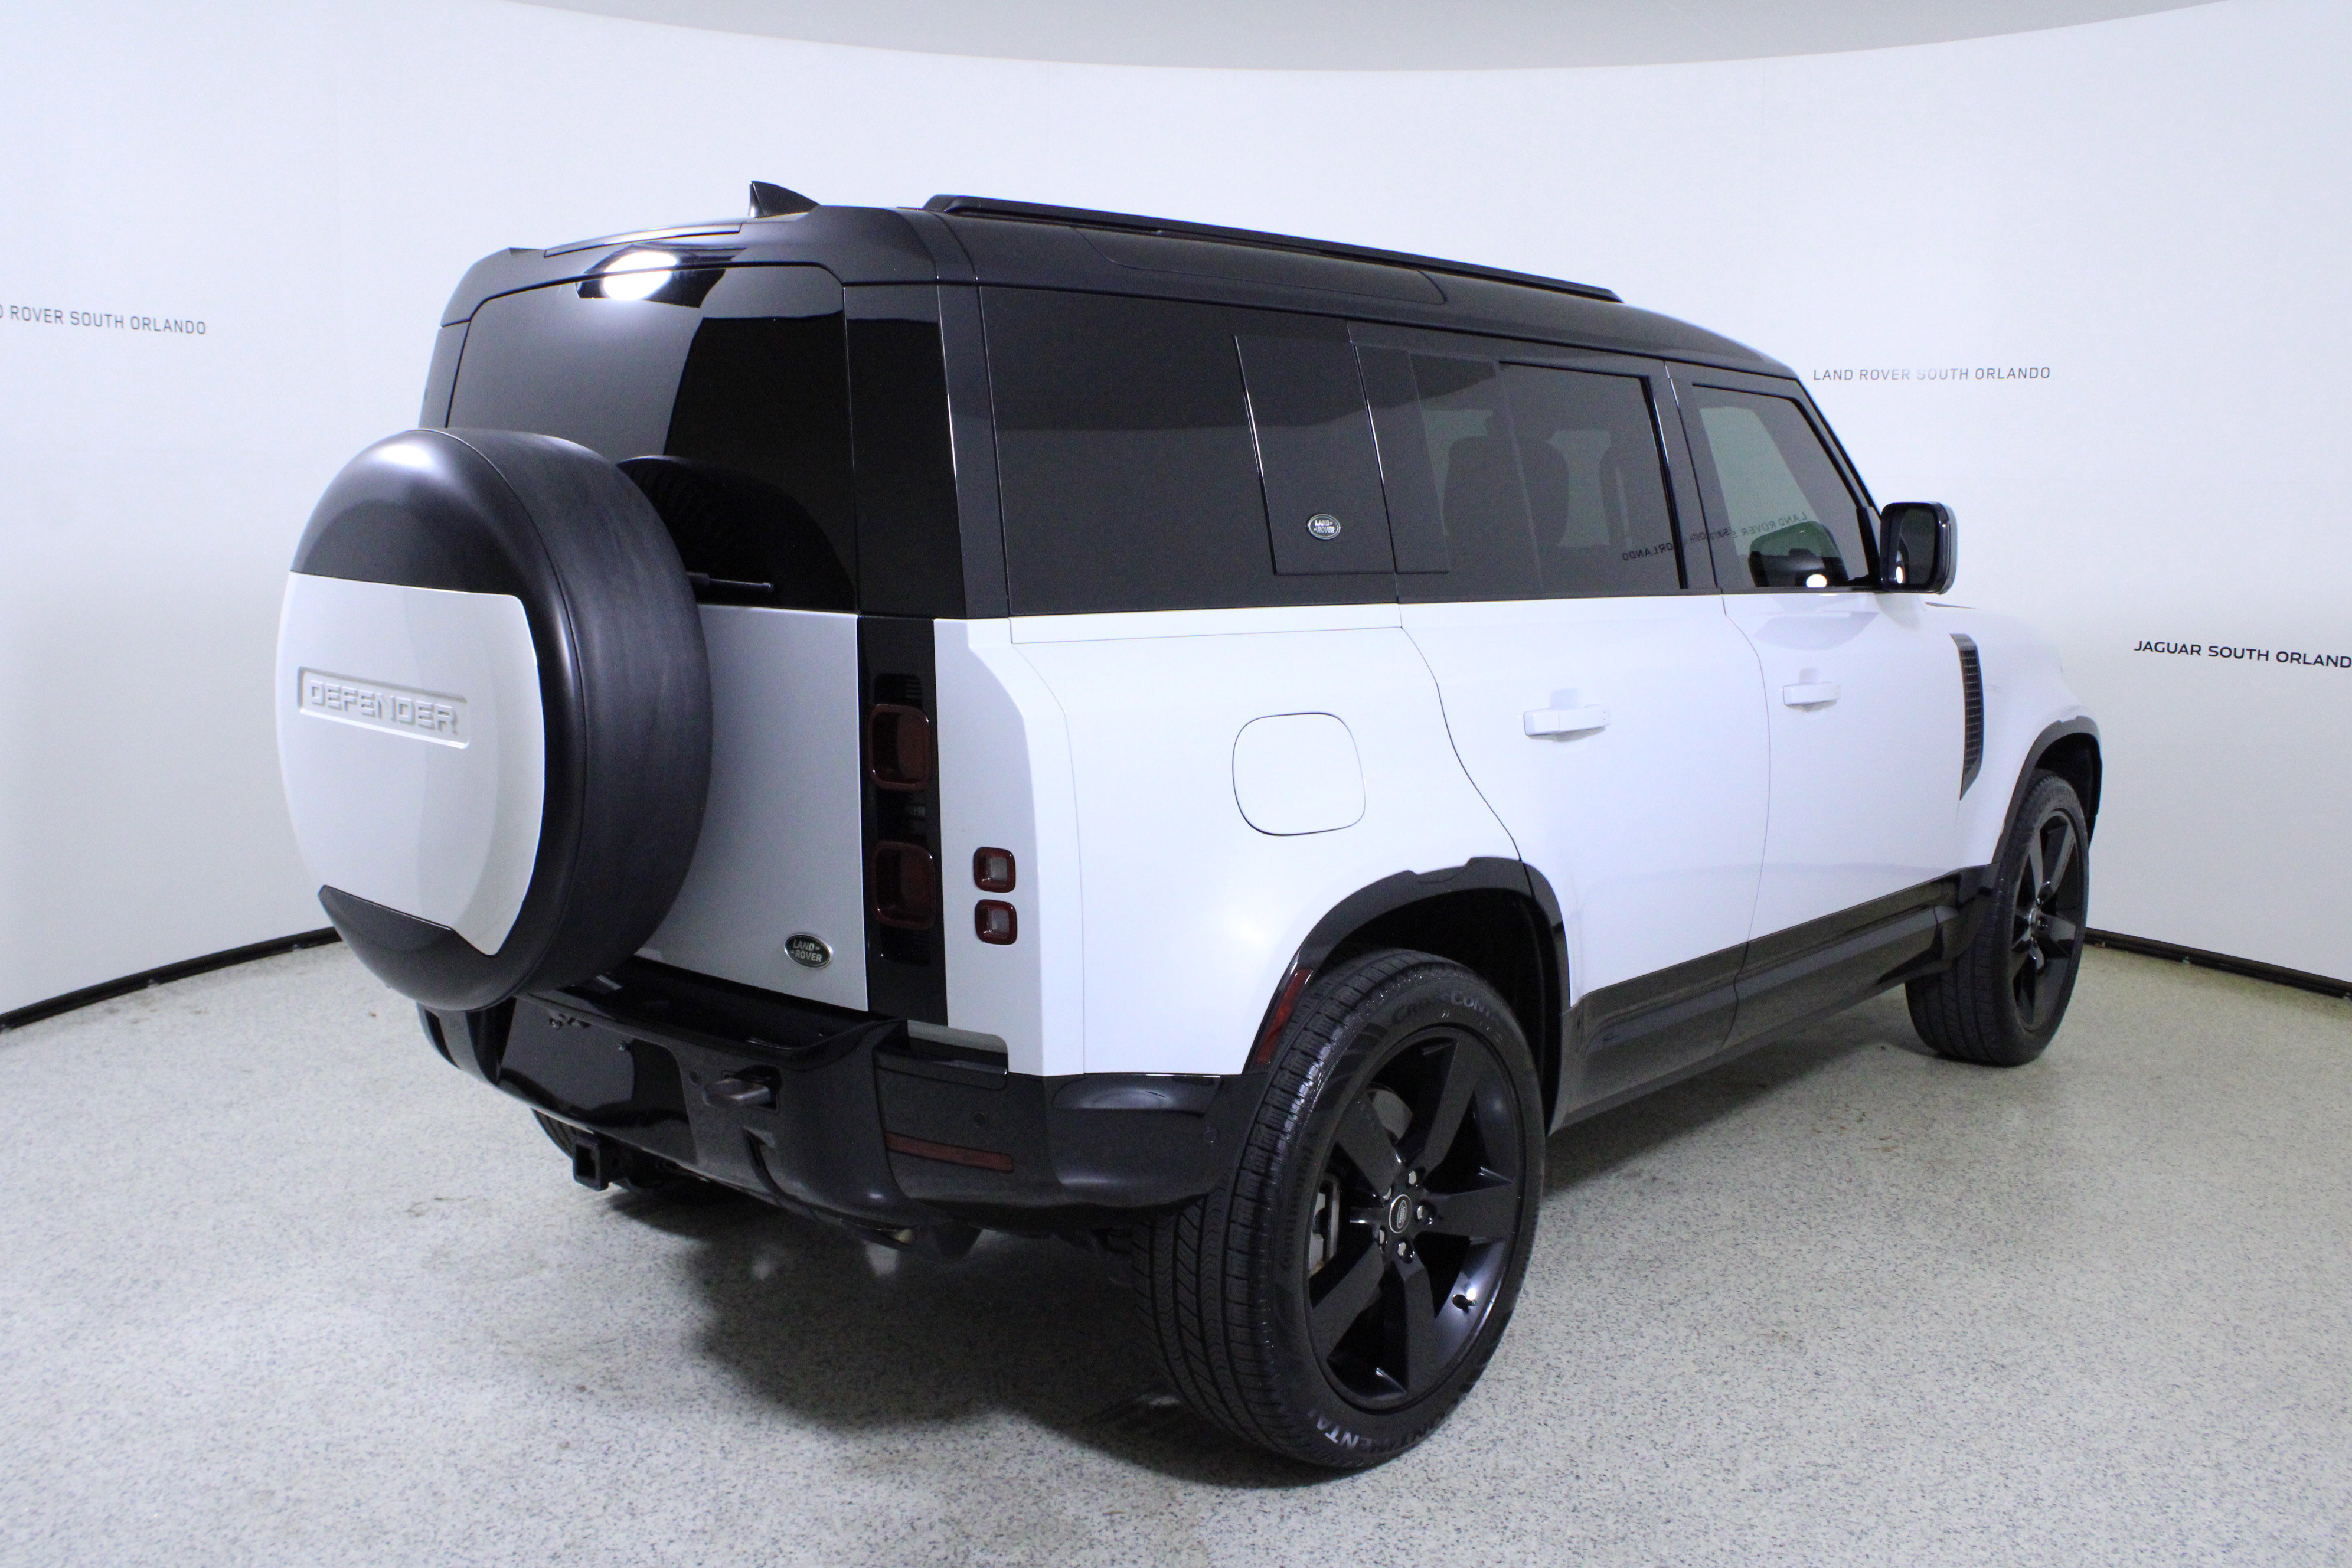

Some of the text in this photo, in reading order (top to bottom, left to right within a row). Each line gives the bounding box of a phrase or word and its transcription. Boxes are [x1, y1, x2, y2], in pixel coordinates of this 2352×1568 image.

[10, 305, 63, 324] ROVER
[70, 311, 124, 328] SOUTH
[130, 316, 206, 335] ORLANDO
[1813, 367, 2050, 381] LAND ROVER SOUTH ORLANDO
[2134, 641, 2352, 668] JAGUAR SOUTH ORLAND
[310, 680, 458, 736] DEFENDER
[792, 939, 815, 952] LAND
[795, 949, 822, 962] ROVER
